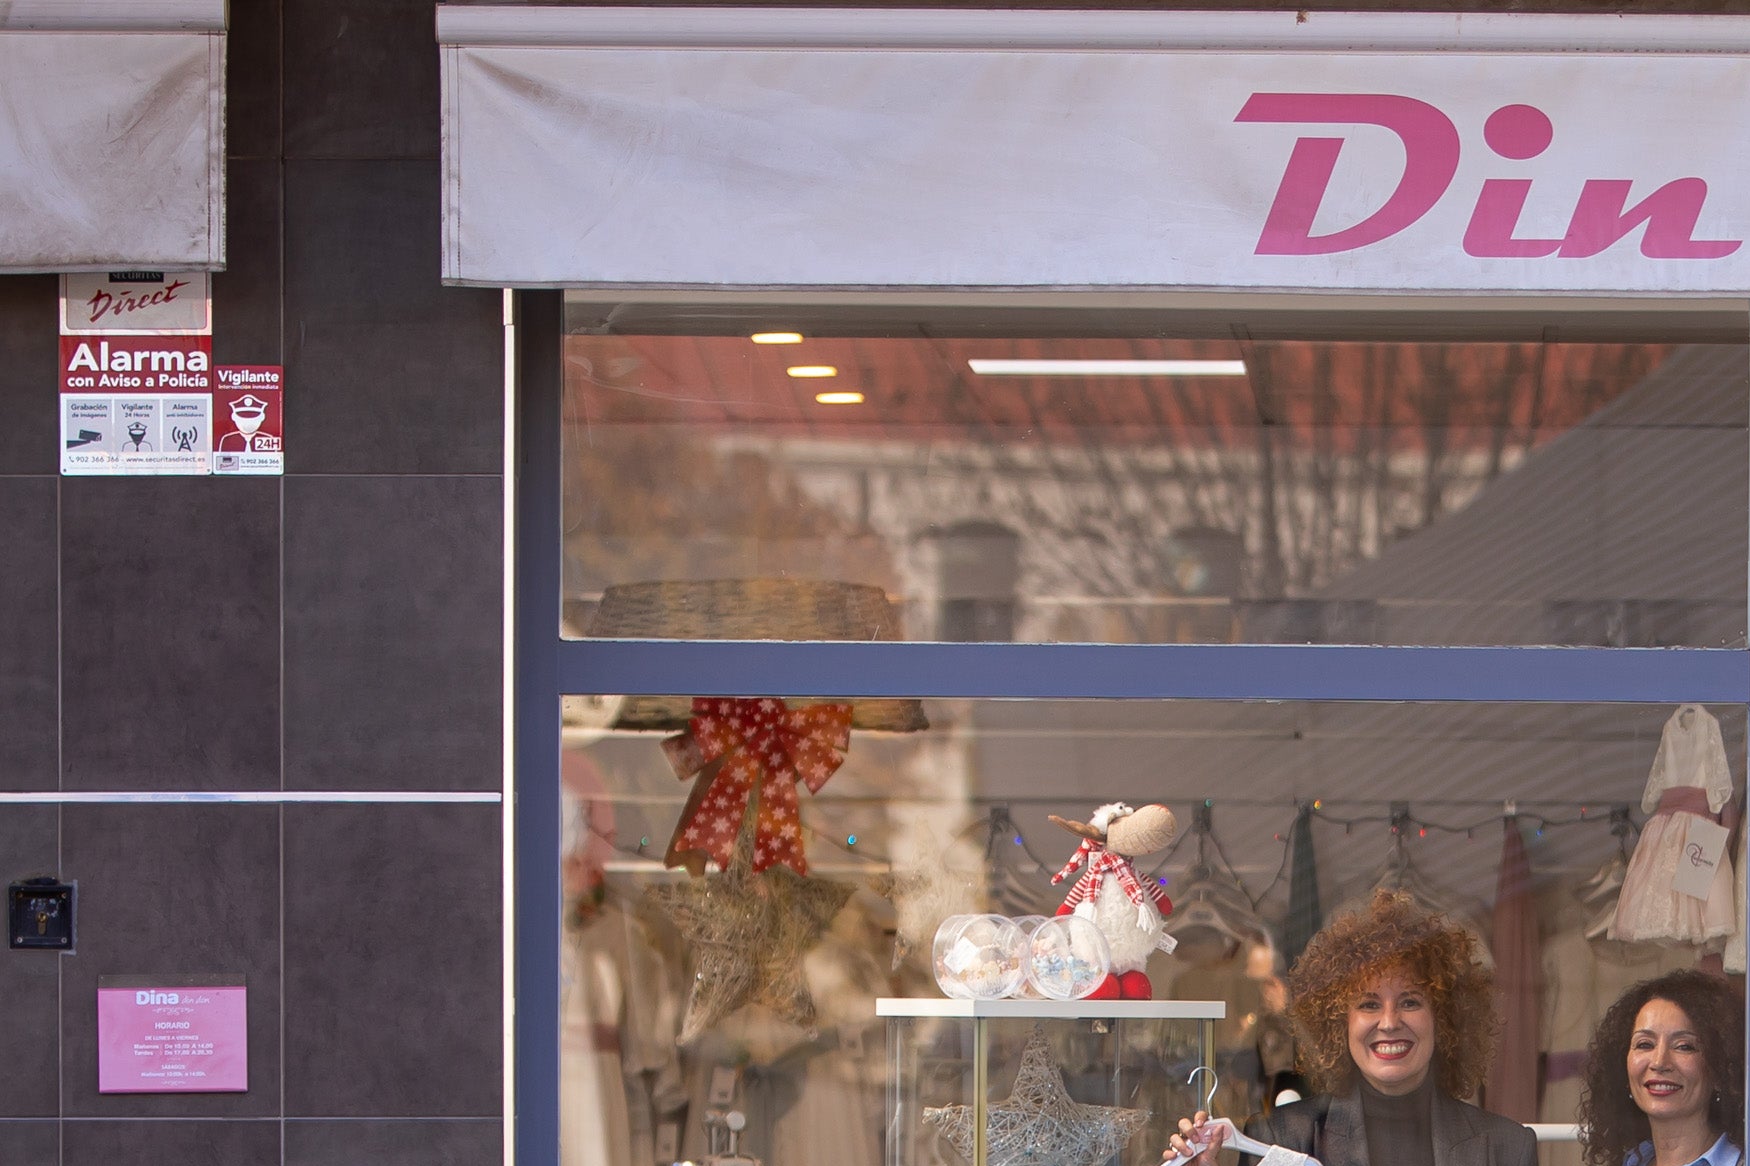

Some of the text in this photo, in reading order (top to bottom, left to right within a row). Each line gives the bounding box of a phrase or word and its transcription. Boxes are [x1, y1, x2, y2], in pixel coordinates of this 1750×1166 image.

[1233, 92, 1743, 259] Din
[87, 279, 191, 323] Direct
[67, 341, 208, 372] Alarma
[67, 373, 208, 387] con Aviso a Policía
[218, 369, 279, 385] Vigilante
[121, 403, 153, 411] Vigilante
[256, 438, 280, 449] 24H
[136, 989, 179, 1005] Dina
[154, 1021, 190, 1030] HORARIO
